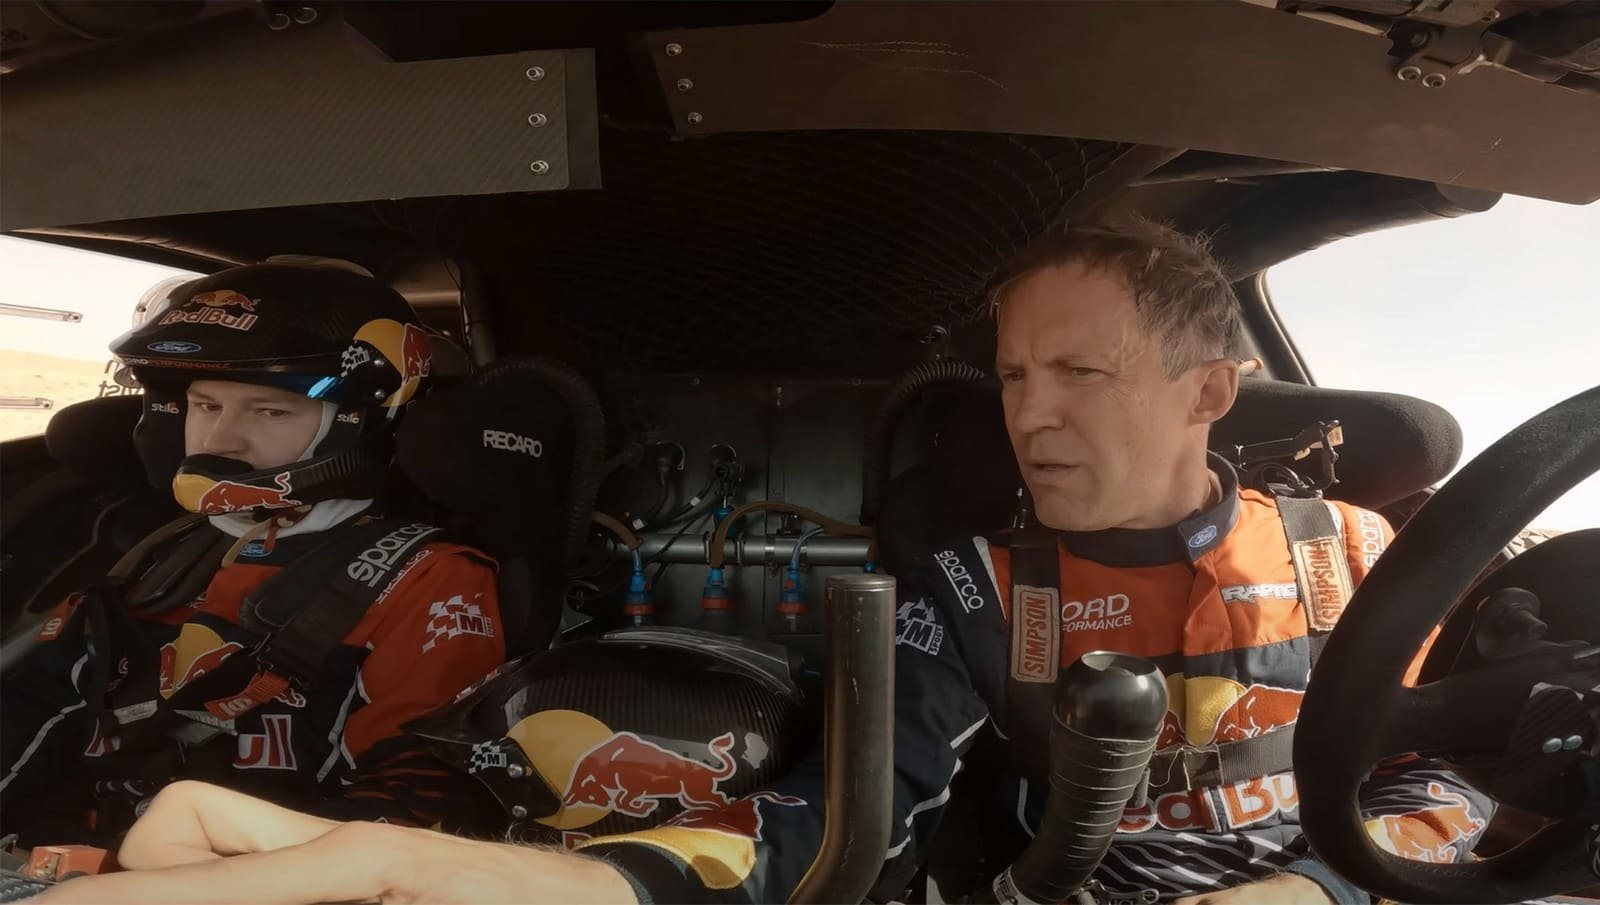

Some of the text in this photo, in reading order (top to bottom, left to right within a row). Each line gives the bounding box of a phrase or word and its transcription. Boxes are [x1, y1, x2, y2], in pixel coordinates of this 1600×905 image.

[483, 430, 543, 458] RECARO
[936, 550, 984, 611] sparco
[1308, 541, 1342, 624] SIMPSON
[1061, 593, 1130, 623] ORD
[1062, 614, 1133, 633] ORMANCE
[1024, 596, 1046, 675] SIMPSON
